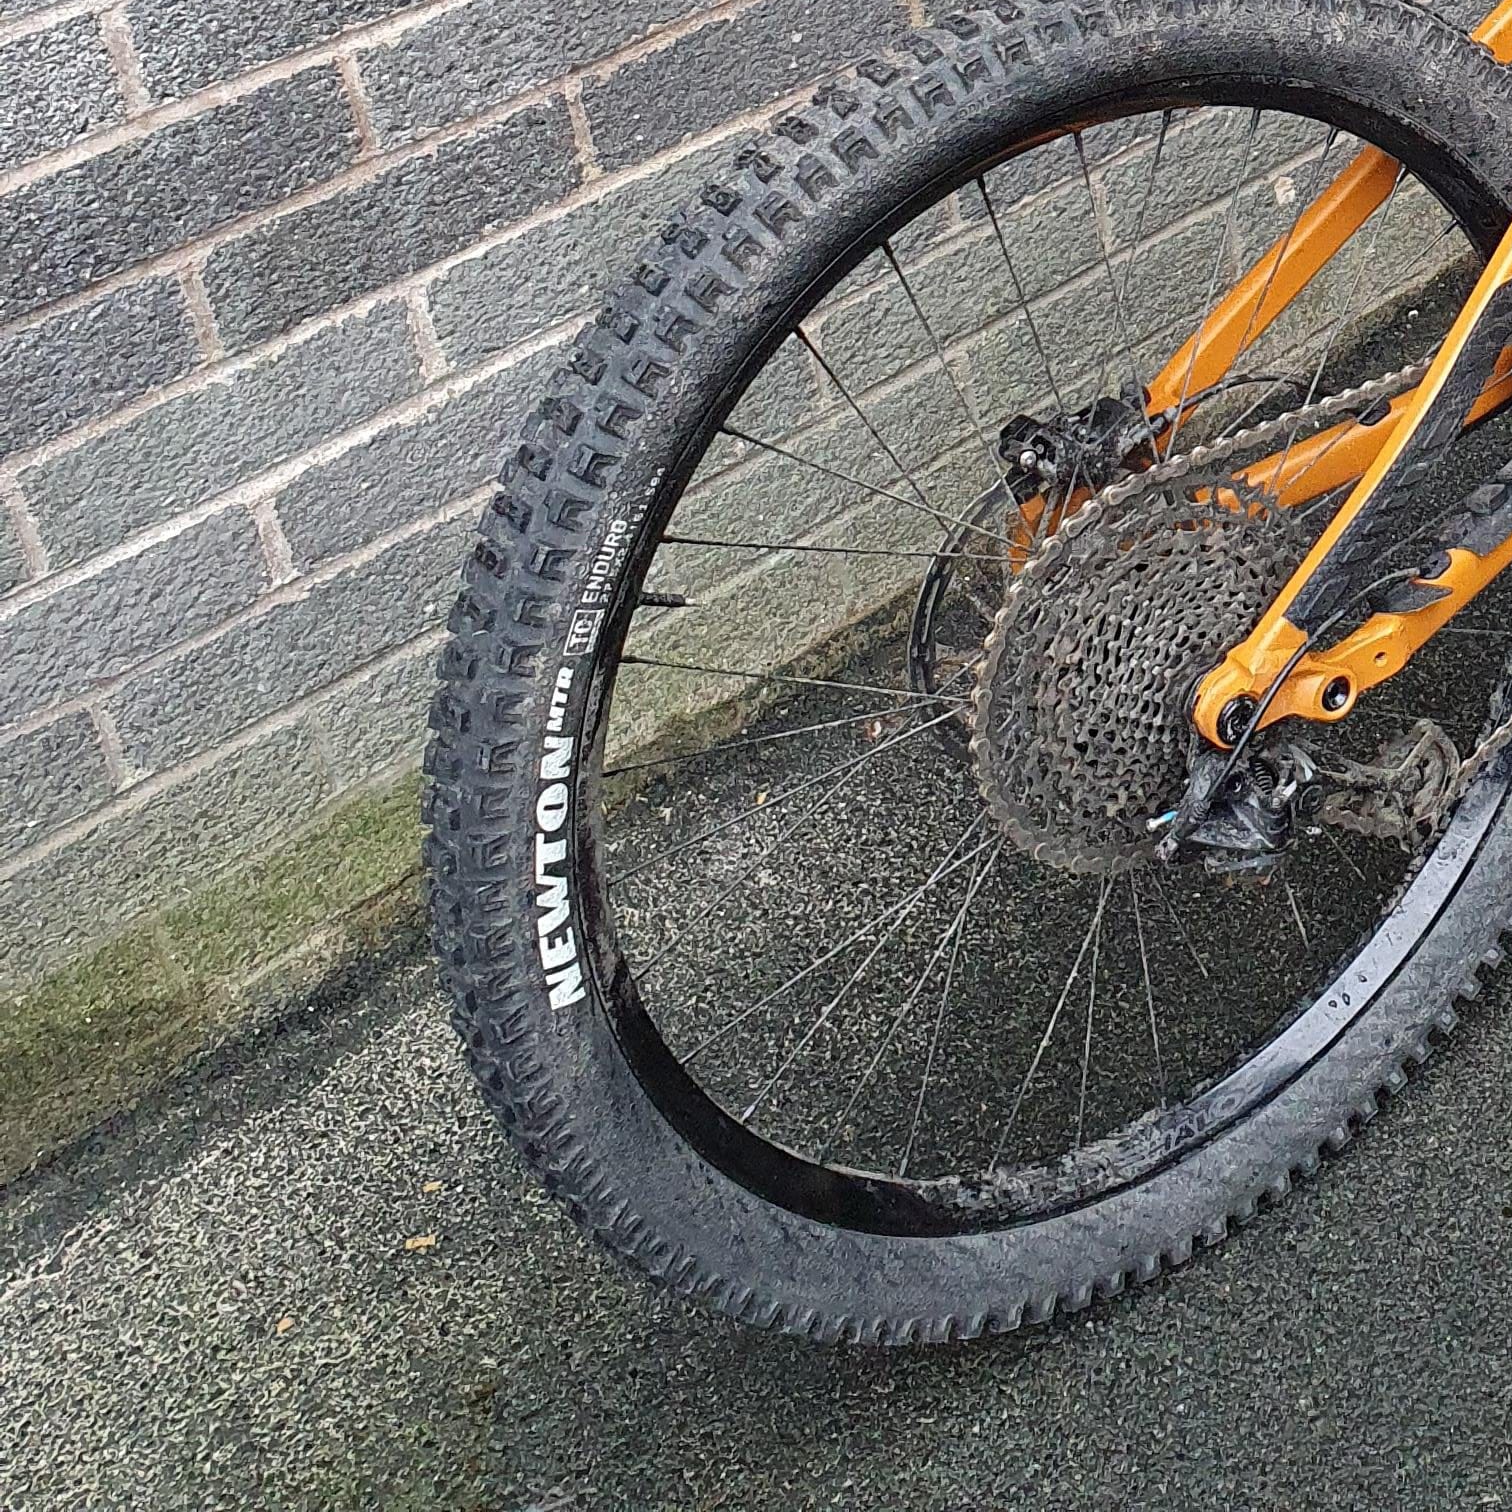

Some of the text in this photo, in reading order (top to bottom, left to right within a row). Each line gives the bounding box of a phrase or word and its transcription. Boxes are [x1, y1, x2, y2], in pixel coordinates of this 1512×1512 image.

[581, 518, 629, 605] ENDURO
[546, 666, 575, 732] MTR
[534, 735, 586, 1011] NEWTON
